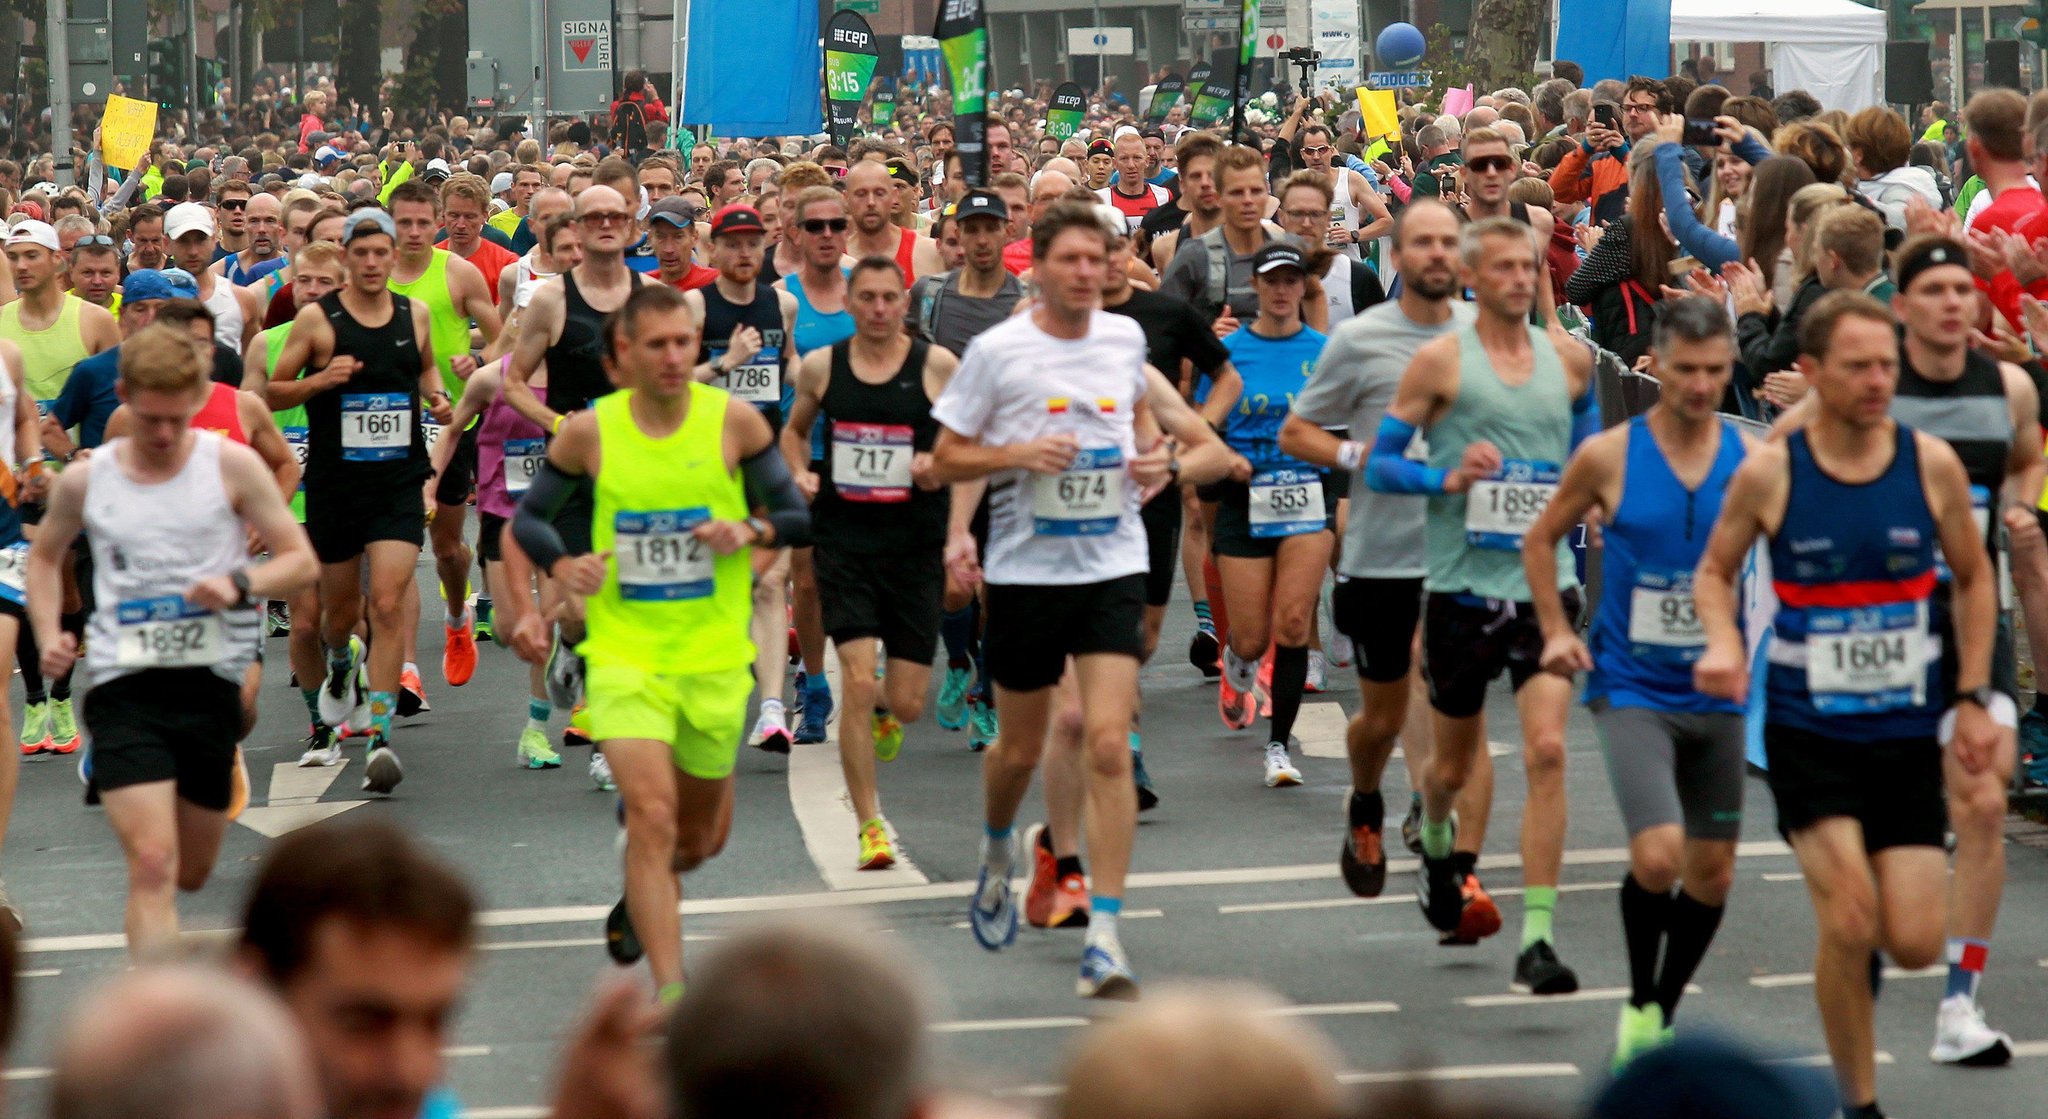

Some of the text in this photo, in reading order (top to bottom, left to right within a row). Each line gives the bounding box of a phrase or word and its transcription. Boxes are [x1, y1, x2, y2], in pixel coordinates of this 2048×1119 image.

[845, 30, 868, 48] cep
[828, 69, 860, 93] 3:15
[1214, 87, 1230, 97] cep
[1065, 95, 1080, 107] cep
[1048, 121, 1072, 136] 3:30
[725, 368, 770, 388] 1786
[356, 414, 401, 433] 1661
[853, 447, 894, 471] 717
[1058, 475, 1106, 502] 674
[1270, 486, 1308, 510] 553
[635, 536, 704, 565] 1812
[138, 622, 204, 654] 1892
[1833, 636, 1905, 671] 1604
